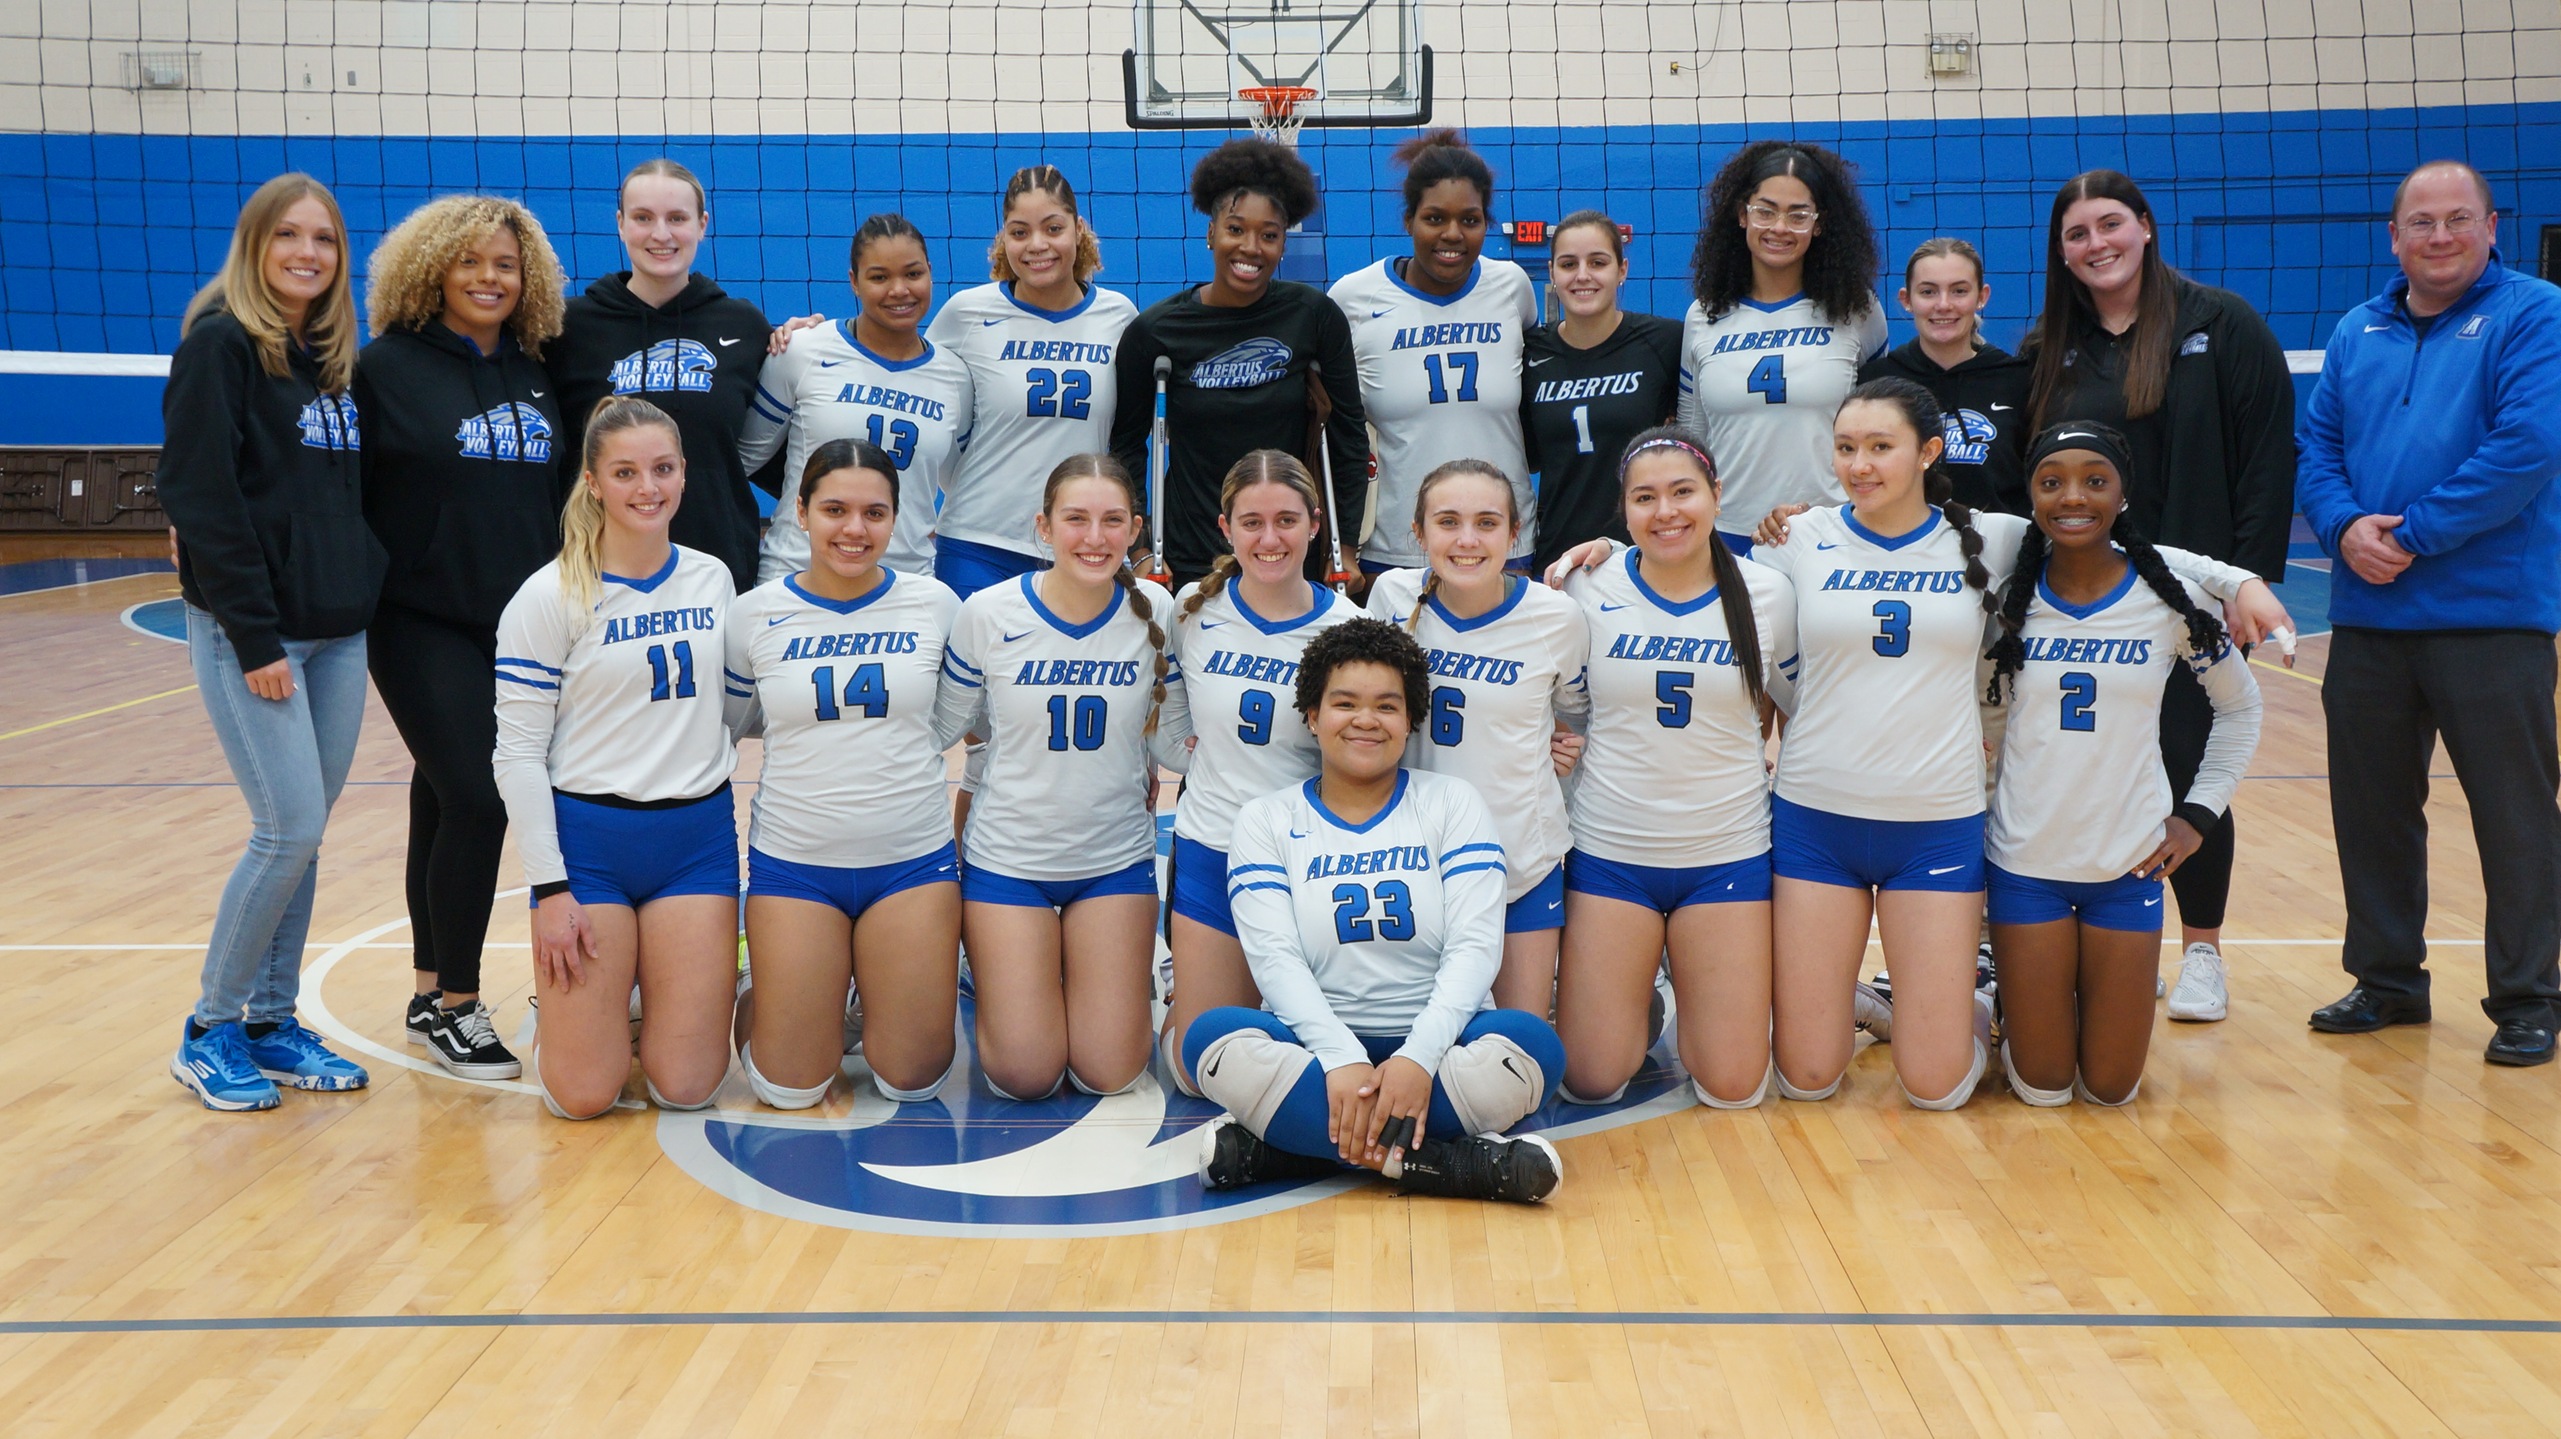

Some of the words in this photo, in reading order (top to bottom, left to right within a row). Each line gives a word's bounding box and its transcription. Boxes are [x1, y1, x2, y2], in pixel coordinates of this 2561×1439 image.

[1517, 221, 1545, 242] EXIT
[996, 340, 1112, 365] ALBERTUS
[1389, 322, 1502, 351] ALBERTUS
[1710, 326, 1834, 356] ALBERTUS
[614, 360, 686, 376] ALBRTUS
[1194, 361, 1263, 378] ALBERTUS
[1198, 371, 1281, 389] VOLLEYBALL
[1423, 351, 1479, 404] 17
[1534, 371, 1644, 402] ALBERTUS
[1747, 354, 1787, 404] 4
[834, 382, 946, 421] ALBERTUS
[1026, 367, 1092, 420] 22
[866, 413, 919, 471] 13
[1572, 405, 1595, 454] 1
[1819, 569, 1966, 594] ALBERTUS
[600, 606, 715, 646] ALBERTUS
[1873, 600, 1911, 657] 3
[778, 631, 919, 662] ALBERTUS
[1605, 633, 1744, 666] ALBERTU
[646, 640, 696, 702] 11
[1011, 660, 1139, 687] ALBERTUS
[1202, 650, 1301, 686] ALBERT
[1421, 648, 1524, 686] BERTUS
[811, 662, 889, 721] 14
[1656, 670, 1694, 729] 5
[2059, 671, 2097, 732] 2
[1047, 695, 1107, 751] 10
[1238, 688, 1276, 746] 9
[1430, 686, 1466, 747] 6
[1304, 845, 1431, 883] ALBERTUS
[1332, 879, 1416, 944] 23
